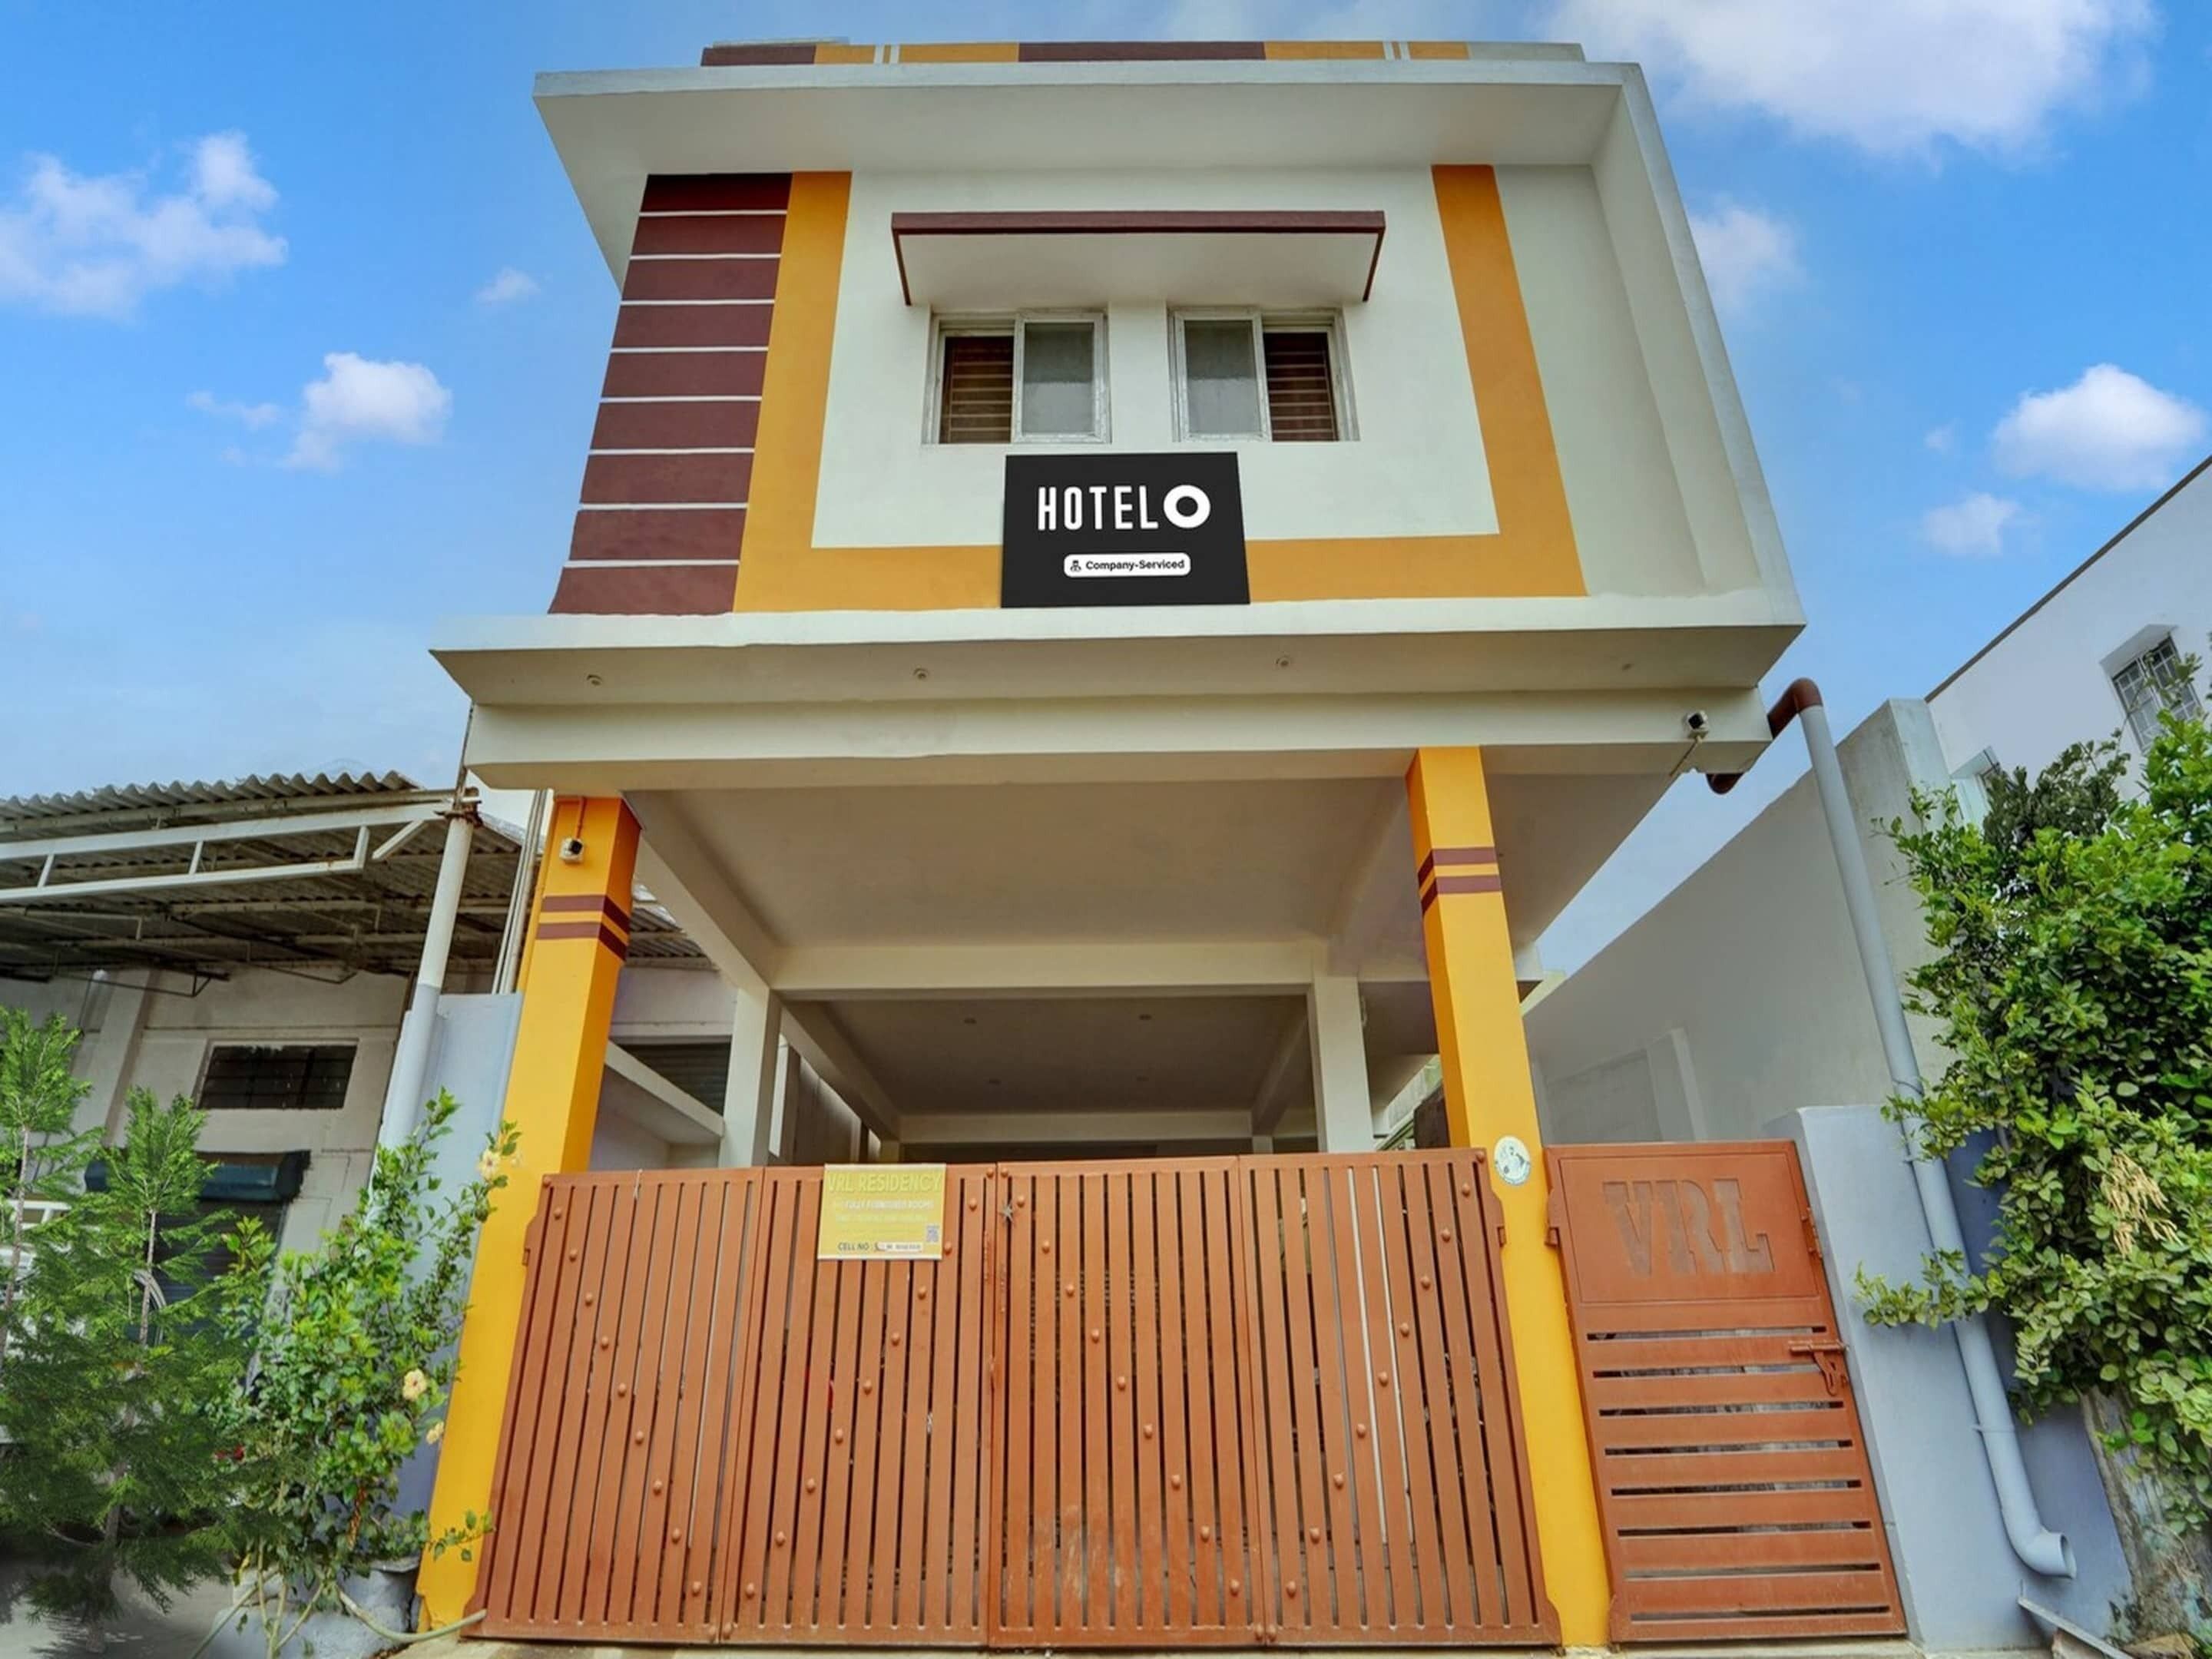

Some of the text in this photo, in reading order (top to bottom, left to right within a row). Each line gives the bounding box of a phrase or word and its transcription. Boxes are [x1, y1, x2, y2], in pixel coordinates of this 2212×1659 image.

[1085, 559, 1185, 572] Company-Serviced
[859, 1171, 942, 1192] RESIDENCY
[1602, 1177, 1776, 1277] VRL
[837, 1241, 856, 1251] CELL
